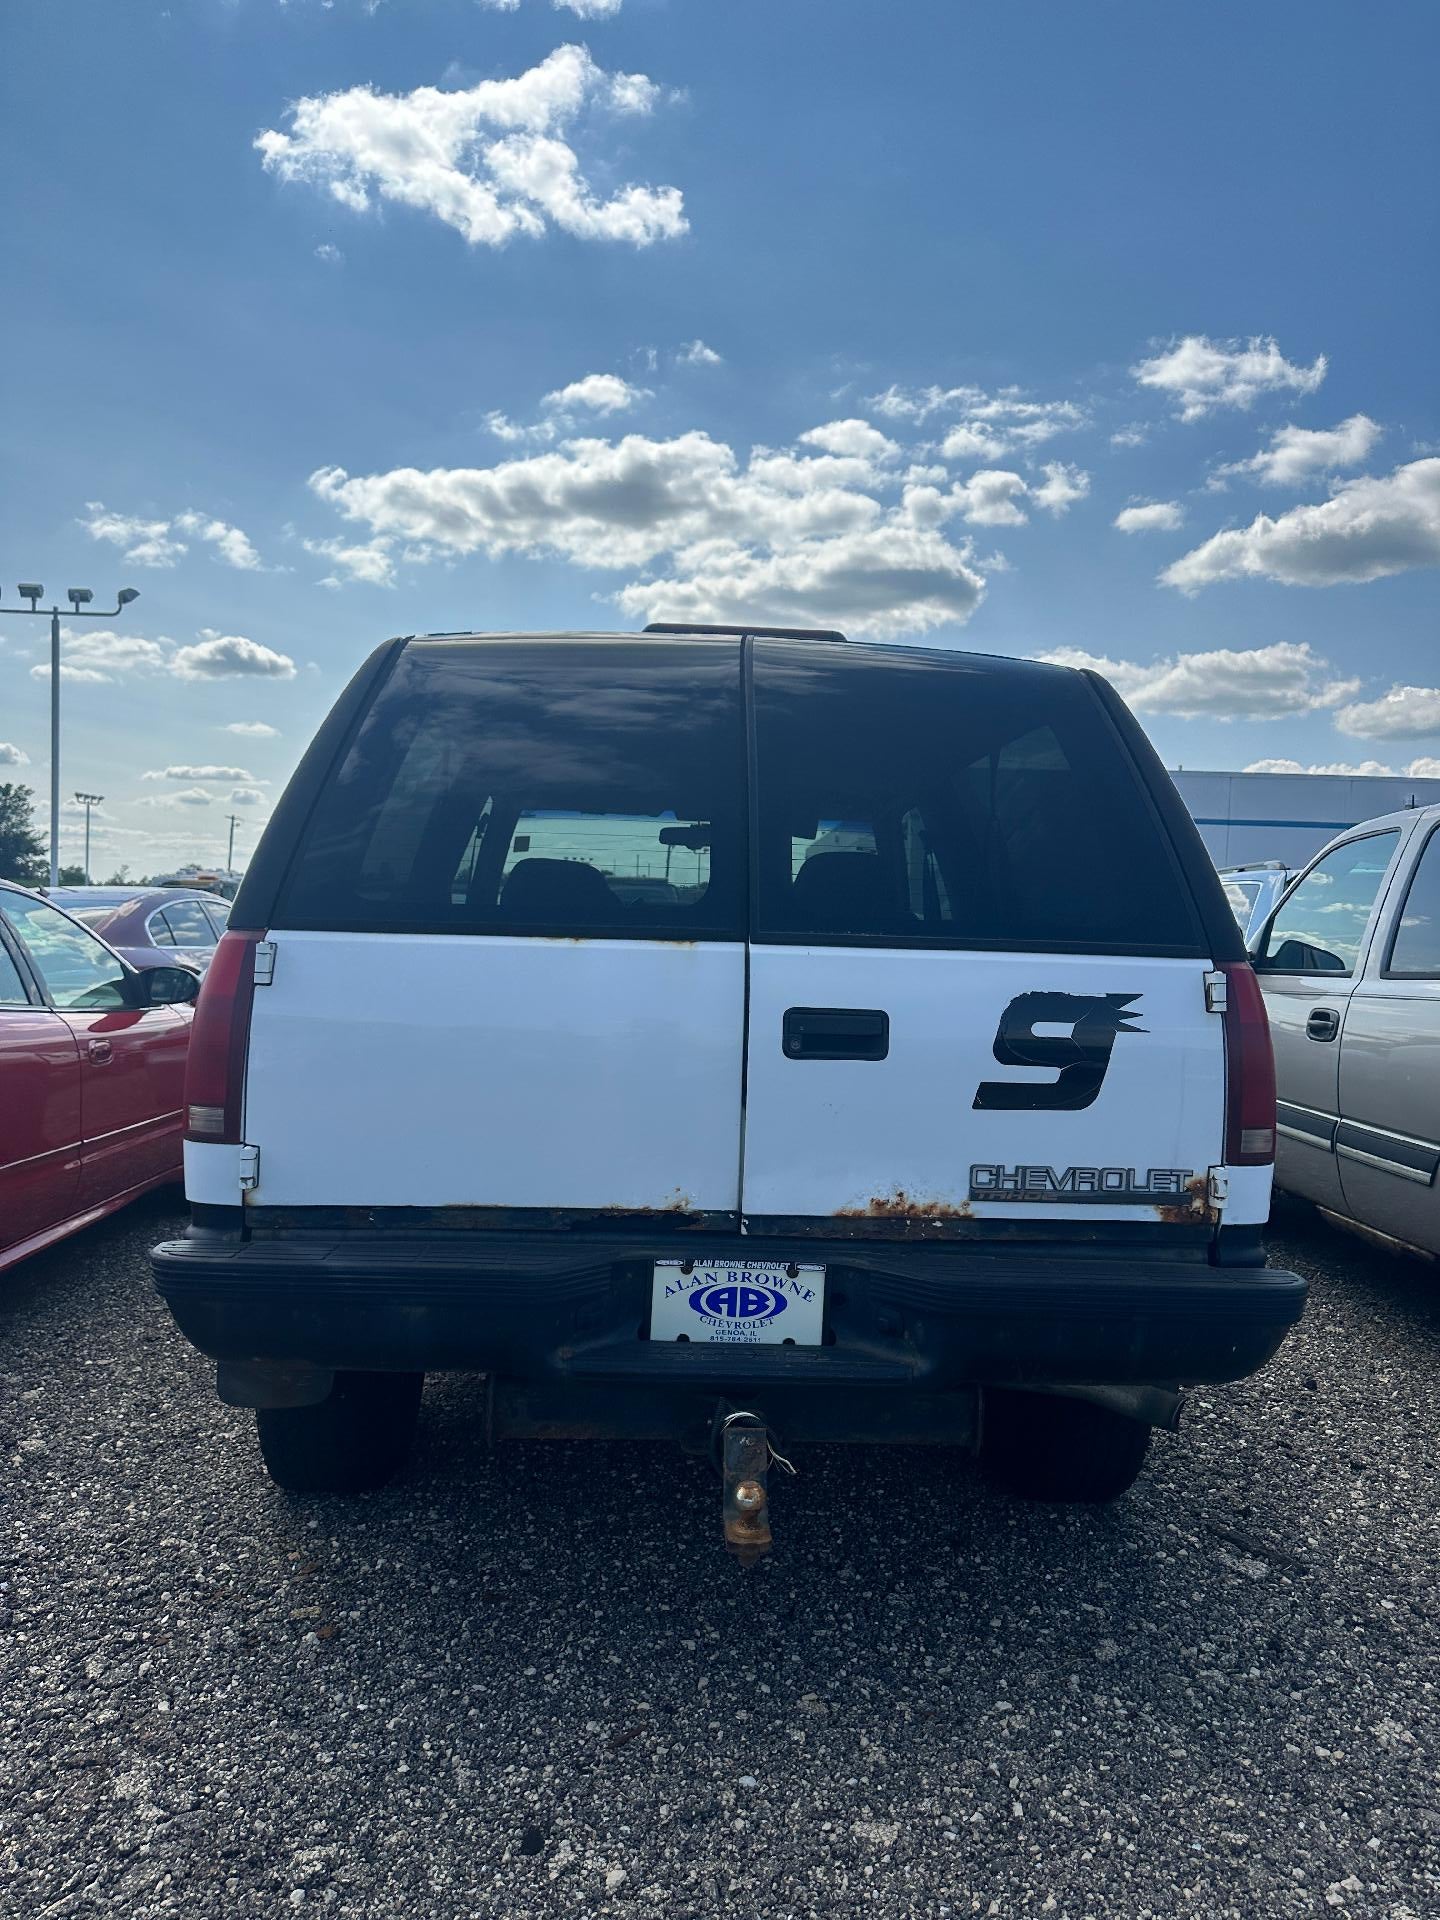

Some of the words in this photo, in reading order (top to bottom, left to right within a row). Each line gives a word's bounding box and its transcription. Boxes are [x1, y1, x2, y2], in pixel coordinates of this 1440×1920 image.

[970, 1164, 1193, 1192] CHEVROLET
[714, 1260, 746, 1269] BROWNE
[747, 1261, 791, 1271] CHEVROLET
[664, 1271, 718, 1298] ALAN
[726, 1270, 816, 1303] BROWNE
[705, 1286, 771, 1318] AB
[699, 1315, 775, 1329] CHEVROLET
[715, 1329, 748, 1337] GENOA,
